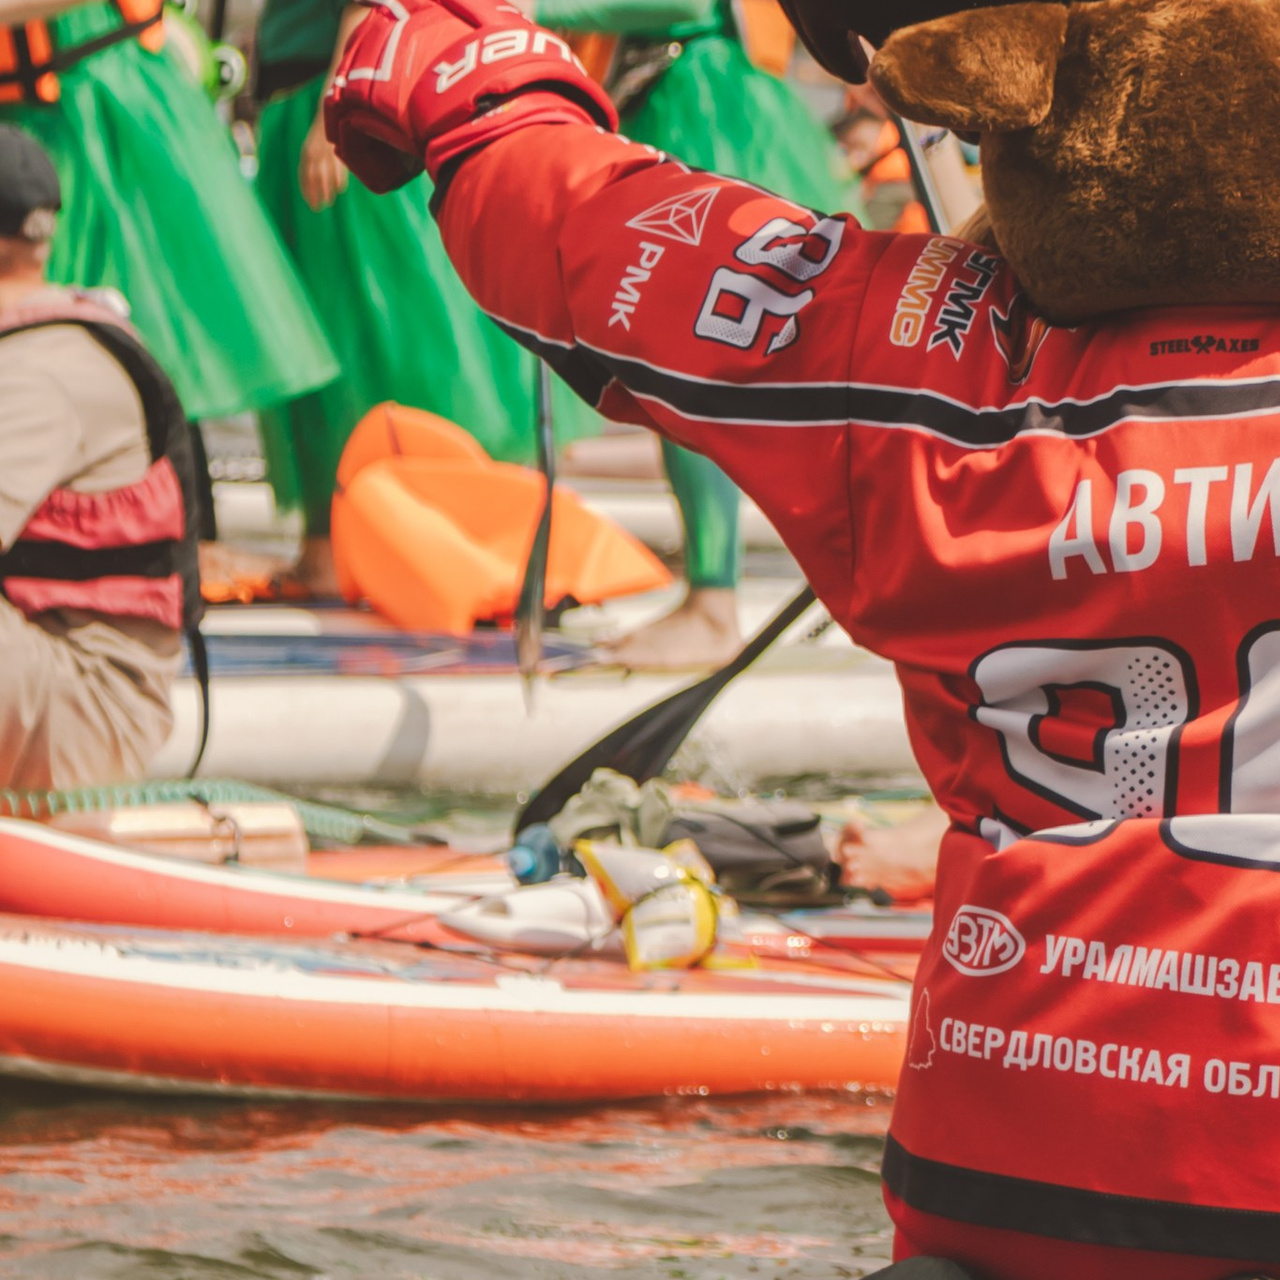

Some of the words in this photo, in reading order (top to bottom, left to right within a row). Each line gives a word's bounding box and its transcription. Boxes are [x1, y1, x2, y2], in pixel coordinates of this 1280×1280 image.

[889, 237, 964, 347] UMMC
[926, 249, 1000, 362] УГМК
[1149, 338, 1192, 356] STEEL
[1215, 337, 1260, 353] AXES
[939, 1016, 1192, 1089] СВЕРДЛОВСКАЯ
